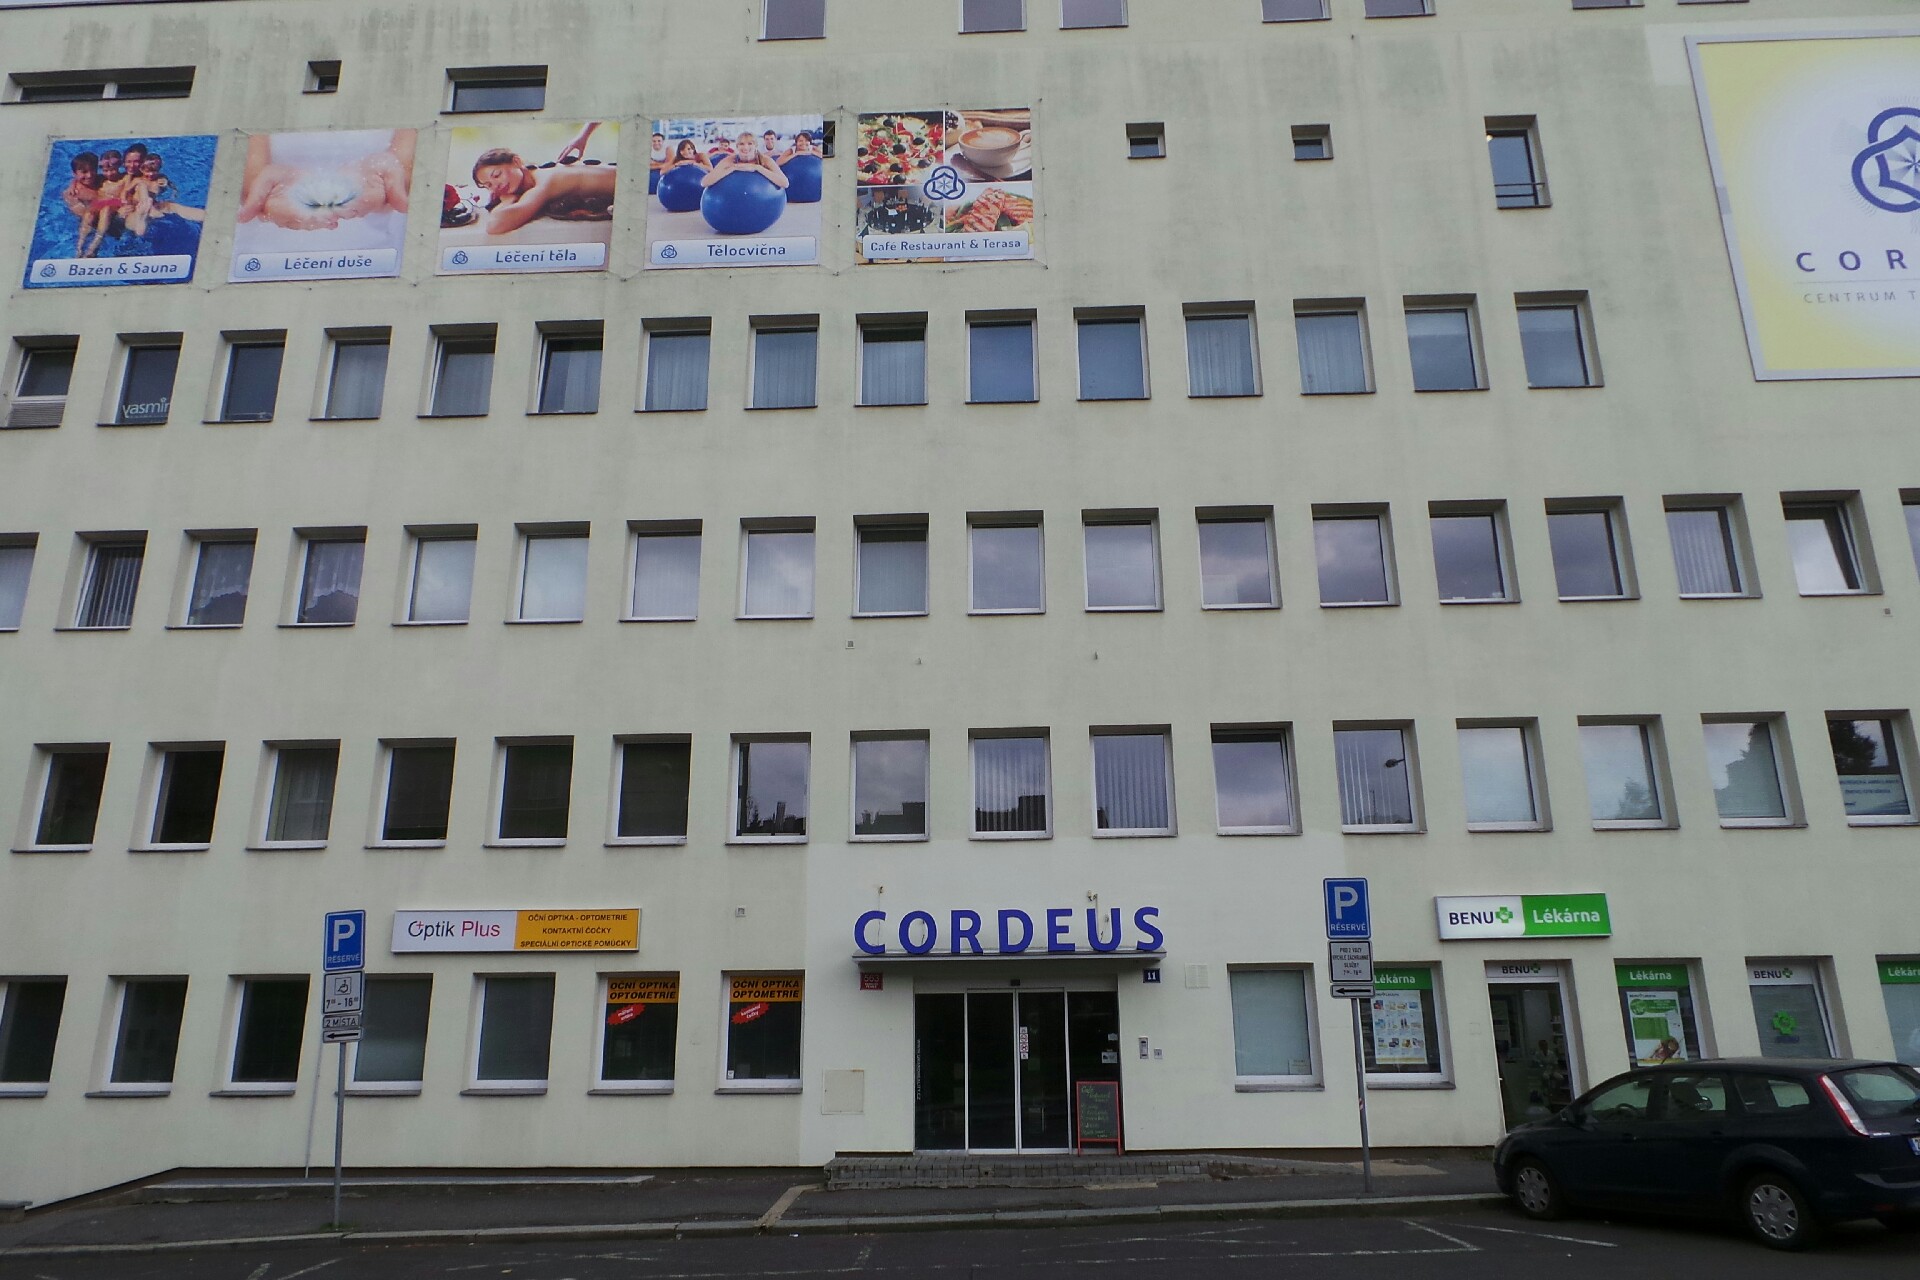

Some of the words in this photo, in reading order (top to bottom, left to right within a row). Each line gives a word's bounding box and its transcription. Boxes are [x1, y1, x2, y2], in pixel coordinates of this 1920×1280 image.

[707, 244, 786, 257] Tělocvična
[870, 241, 897, 252] Café
[901, 240, 966, 251] Restaurant
[970, 240, 979, 249] &
[983, 239, 1021, 249] Terasa
[284, 257, 333, 270] Léčení
[337, 255, 373, 268] duše
[495, 250, 544, 263] Léčení
[549, 249, 577, 262] těla
[1796, 249, 1908, 272] COR
[68, 264, 112, 276] Bazén
[117, 263, 128, 274] &
[132, 262, 178, 274] Sauna
[1803, 291, 1896, 304] CENTRUM
[1333, 886, 1359, 920] P
[547, 914, 576, 922] OPTIKA
[1449, 911, 1494, 925] BENU
[1533, 908, 1600, 924] Lékárna
[333, 919, 355, 952] P
[408, 920, 455, 941] Optik
[461, 920, 501, 938] Plus
[542, 926, 584, 935] KONTAKTNÍ
[854, 906, 1164, 955] CORDEUS
[1147, 971, 1157, 980] 11
[1502, 965, 1530, 974] BENU
[1630, 970, 1672, 981] Lékárna
[1753, 970, 1782, 979] BENU
[761, 980, 800, 988] OPTIKA
[1374, 971, 1416, 984] Lékárna
[639, 981, 677, 990] OPTIKA
[609, 991, 677, 1000] OPTOMETRIE
[732, 989, 800, 999] OPTOMETRIE
